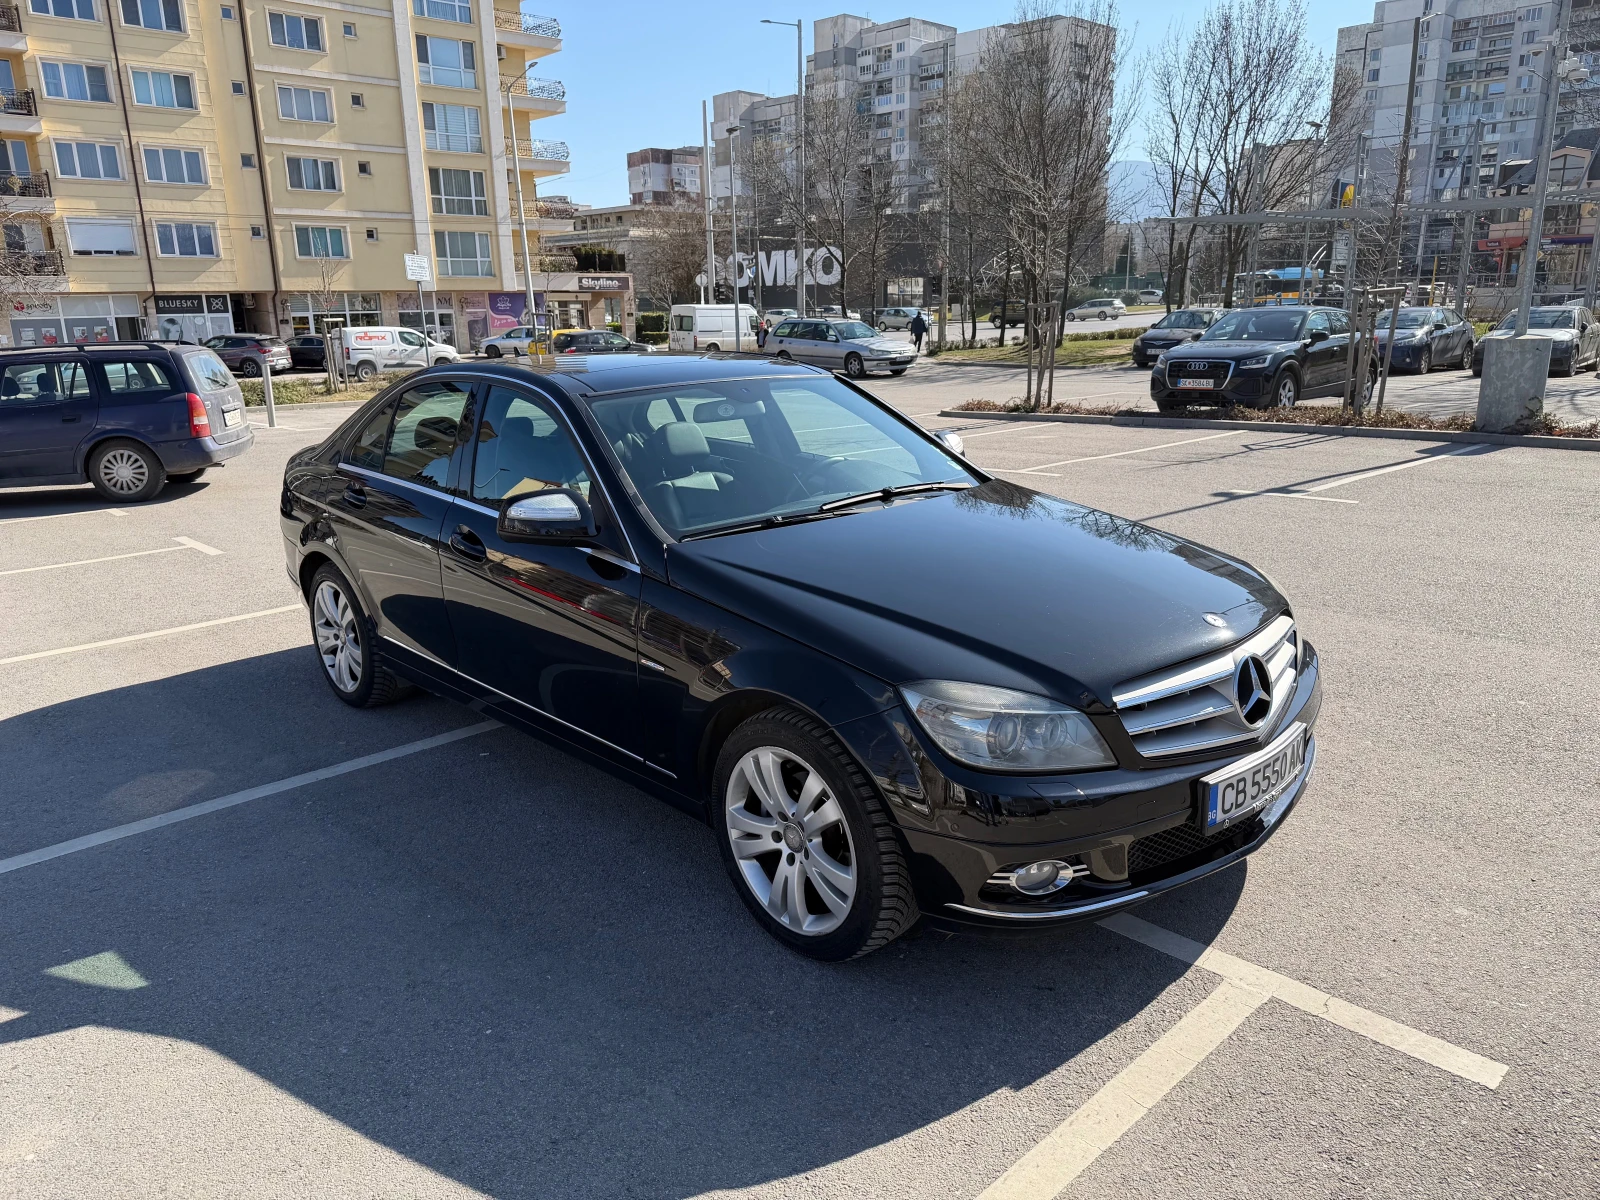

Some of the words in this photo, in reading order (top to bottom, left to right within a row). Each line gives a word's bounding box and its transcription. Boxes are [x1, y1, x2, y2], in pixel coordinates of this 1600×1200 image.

[581, 277, 619, 290] Skyline
[158, 299, 199, 308] BLUESKY
[1221, 776, 1247, 815] CB
[1250, 751, 1288, 801] 5550
[1288, 733, 1305, 777] AK
